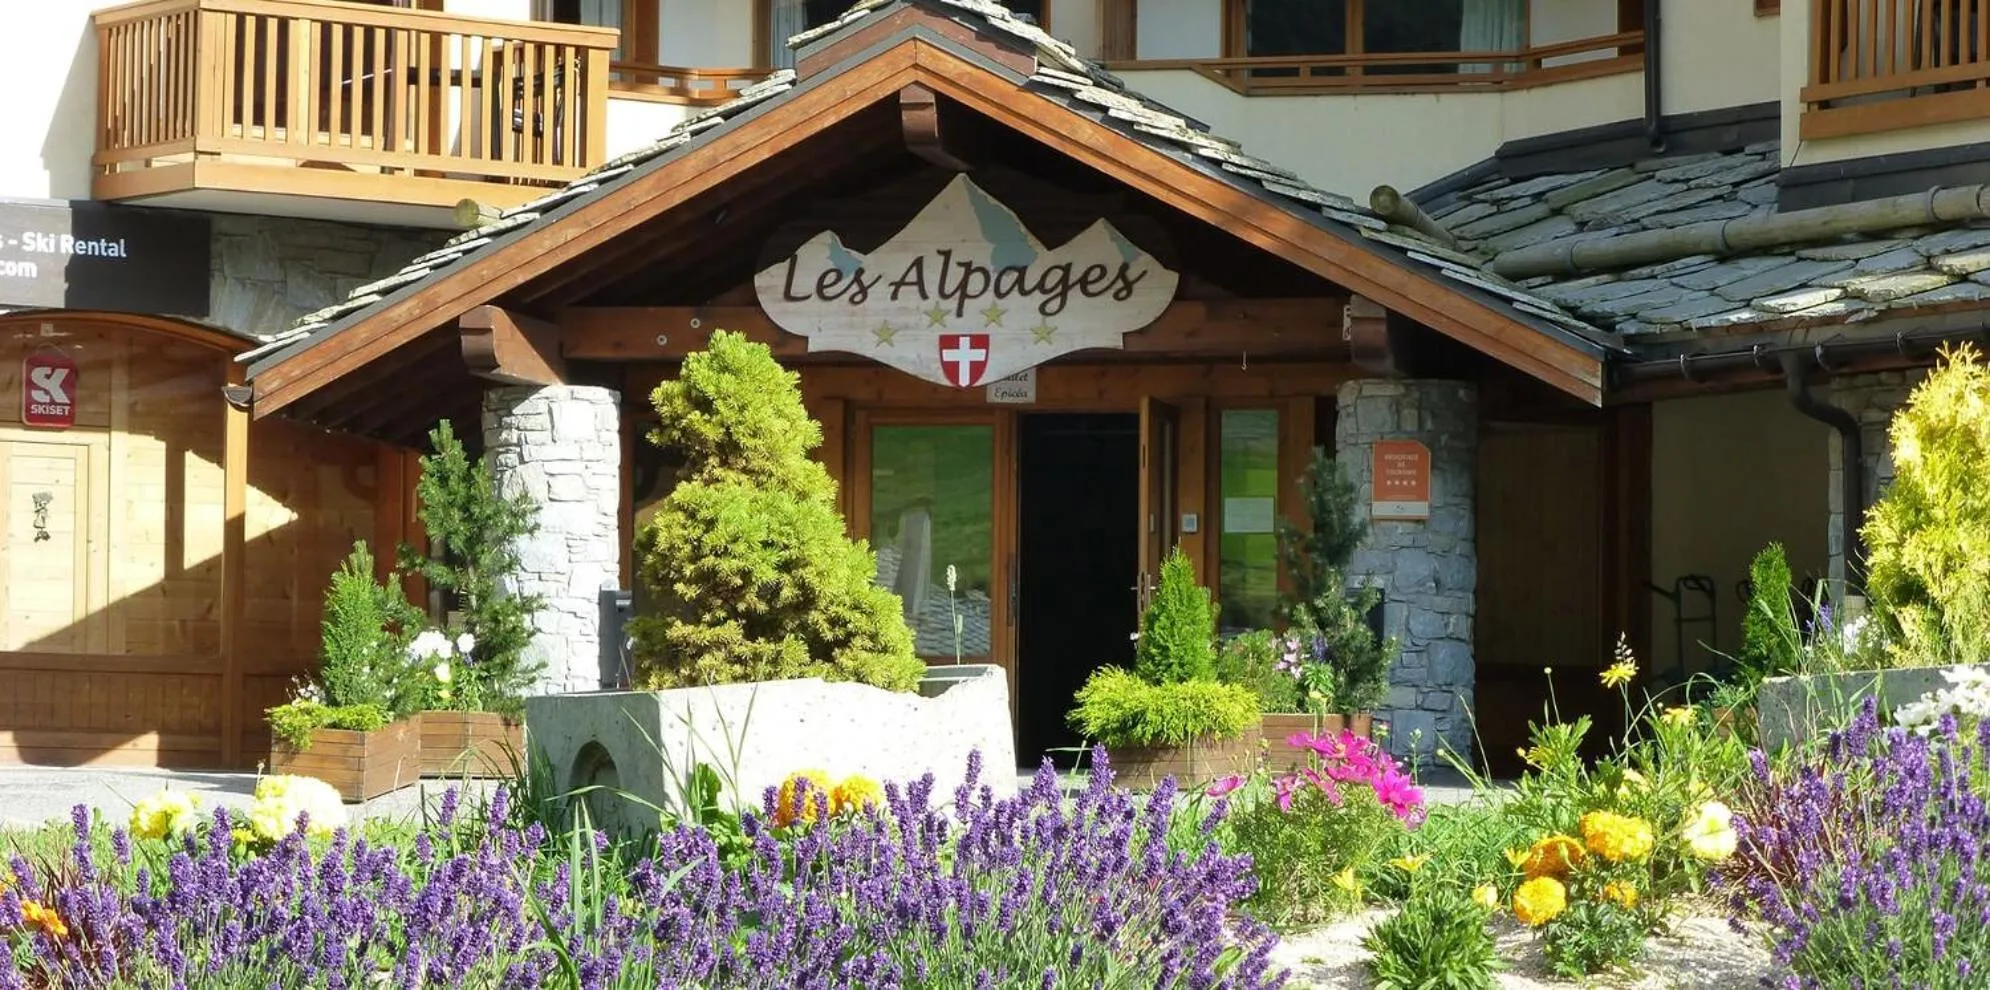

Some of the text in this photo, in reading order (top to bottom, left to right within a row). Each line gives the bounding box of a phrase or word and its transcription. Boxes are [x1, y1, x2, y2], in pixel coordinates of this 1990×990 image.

[22, 232, 55, 253] Ski
[60, 234, 127, 257] Rental
[783, 248, 1148, 318] Les Alpages
[31, 404, 70, 416] SKISET
